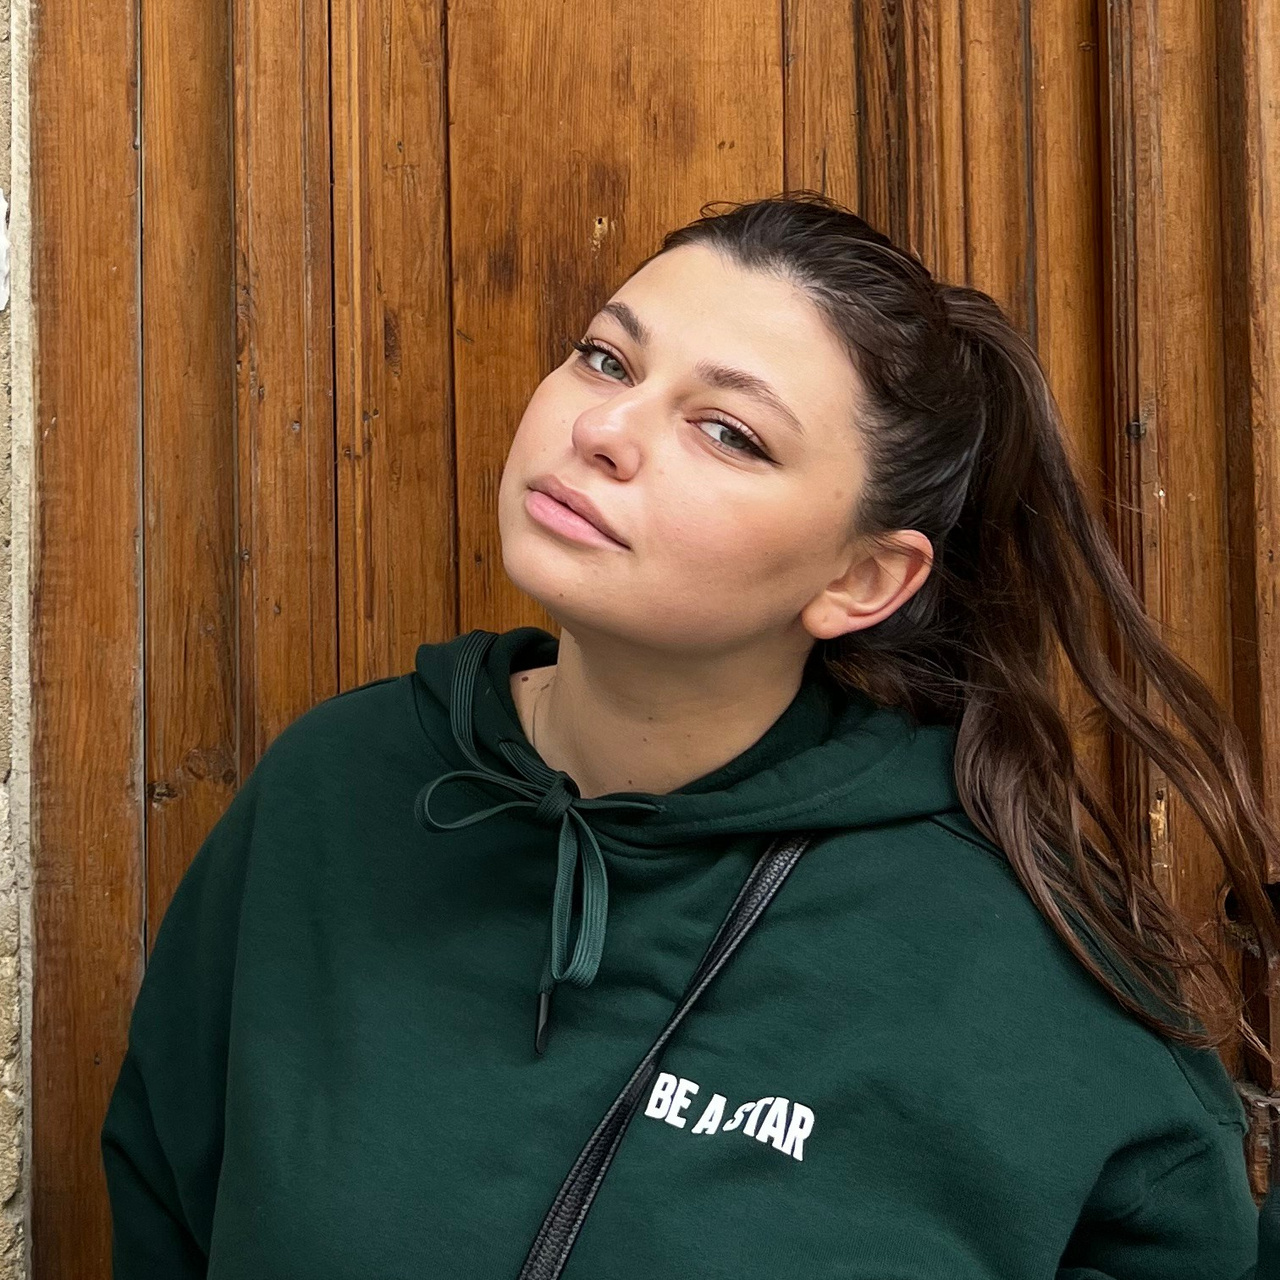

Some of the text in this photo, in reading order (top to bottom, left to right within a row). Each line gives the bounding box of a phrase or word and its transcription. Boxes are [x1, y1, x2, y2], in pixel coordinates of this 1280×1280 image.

[644, 1072, 815, 1161] BE A STAR
